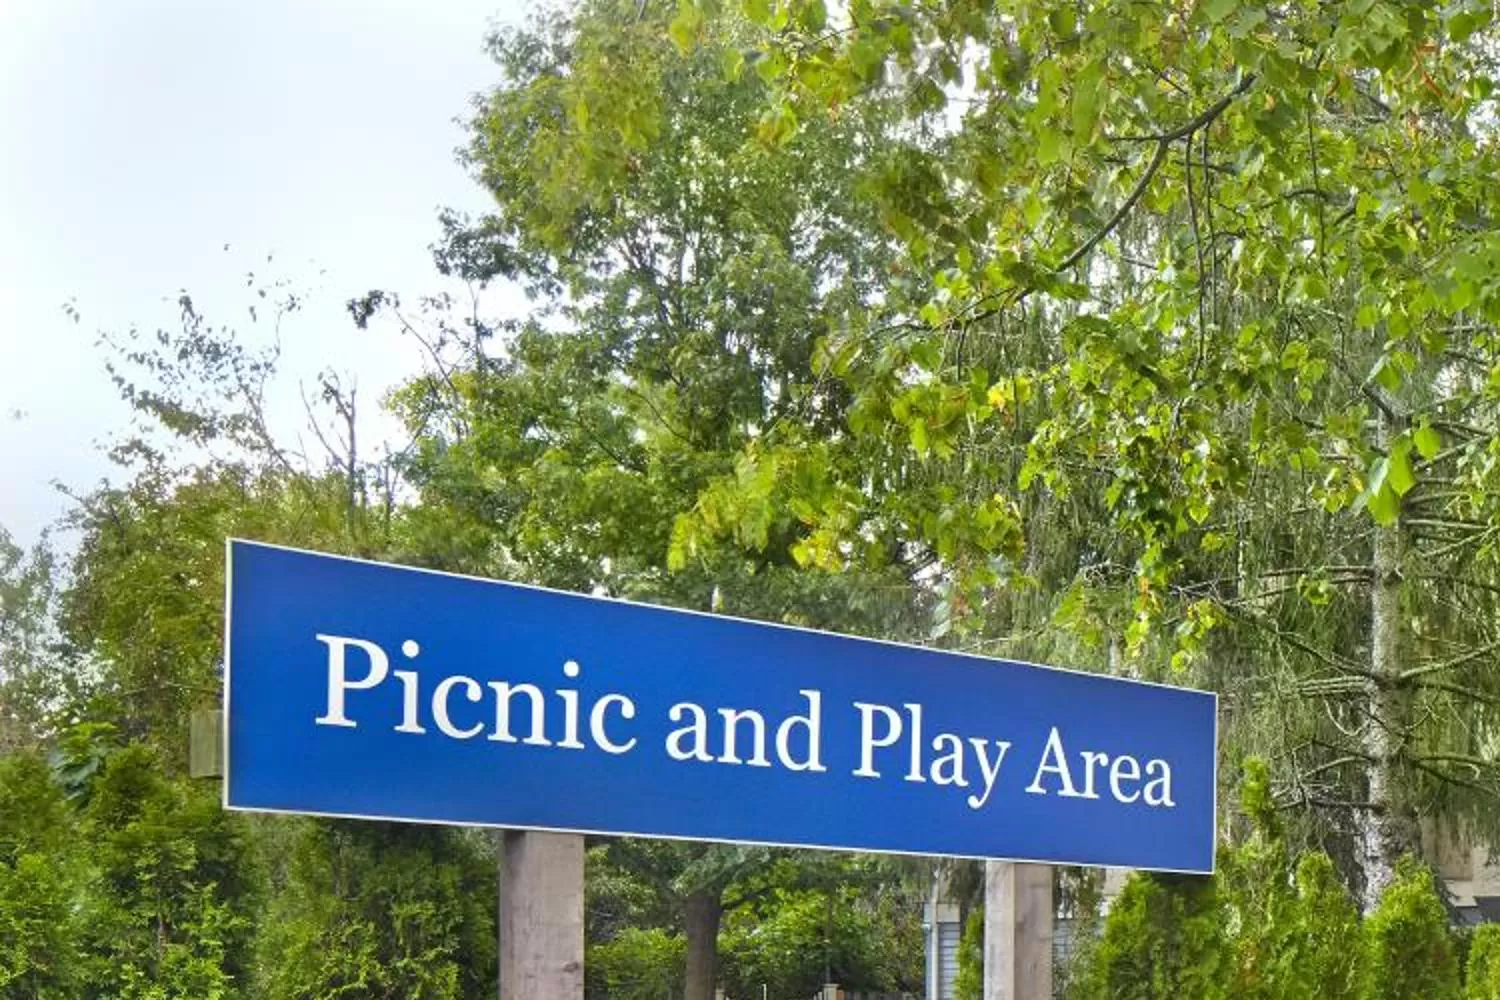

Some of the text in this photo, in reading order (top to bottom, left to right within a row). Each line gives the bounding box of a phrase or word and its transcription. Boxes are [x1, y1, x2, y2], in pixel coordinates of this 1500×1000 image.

[314, 634, 1177, 809] Picnic and Play Area
